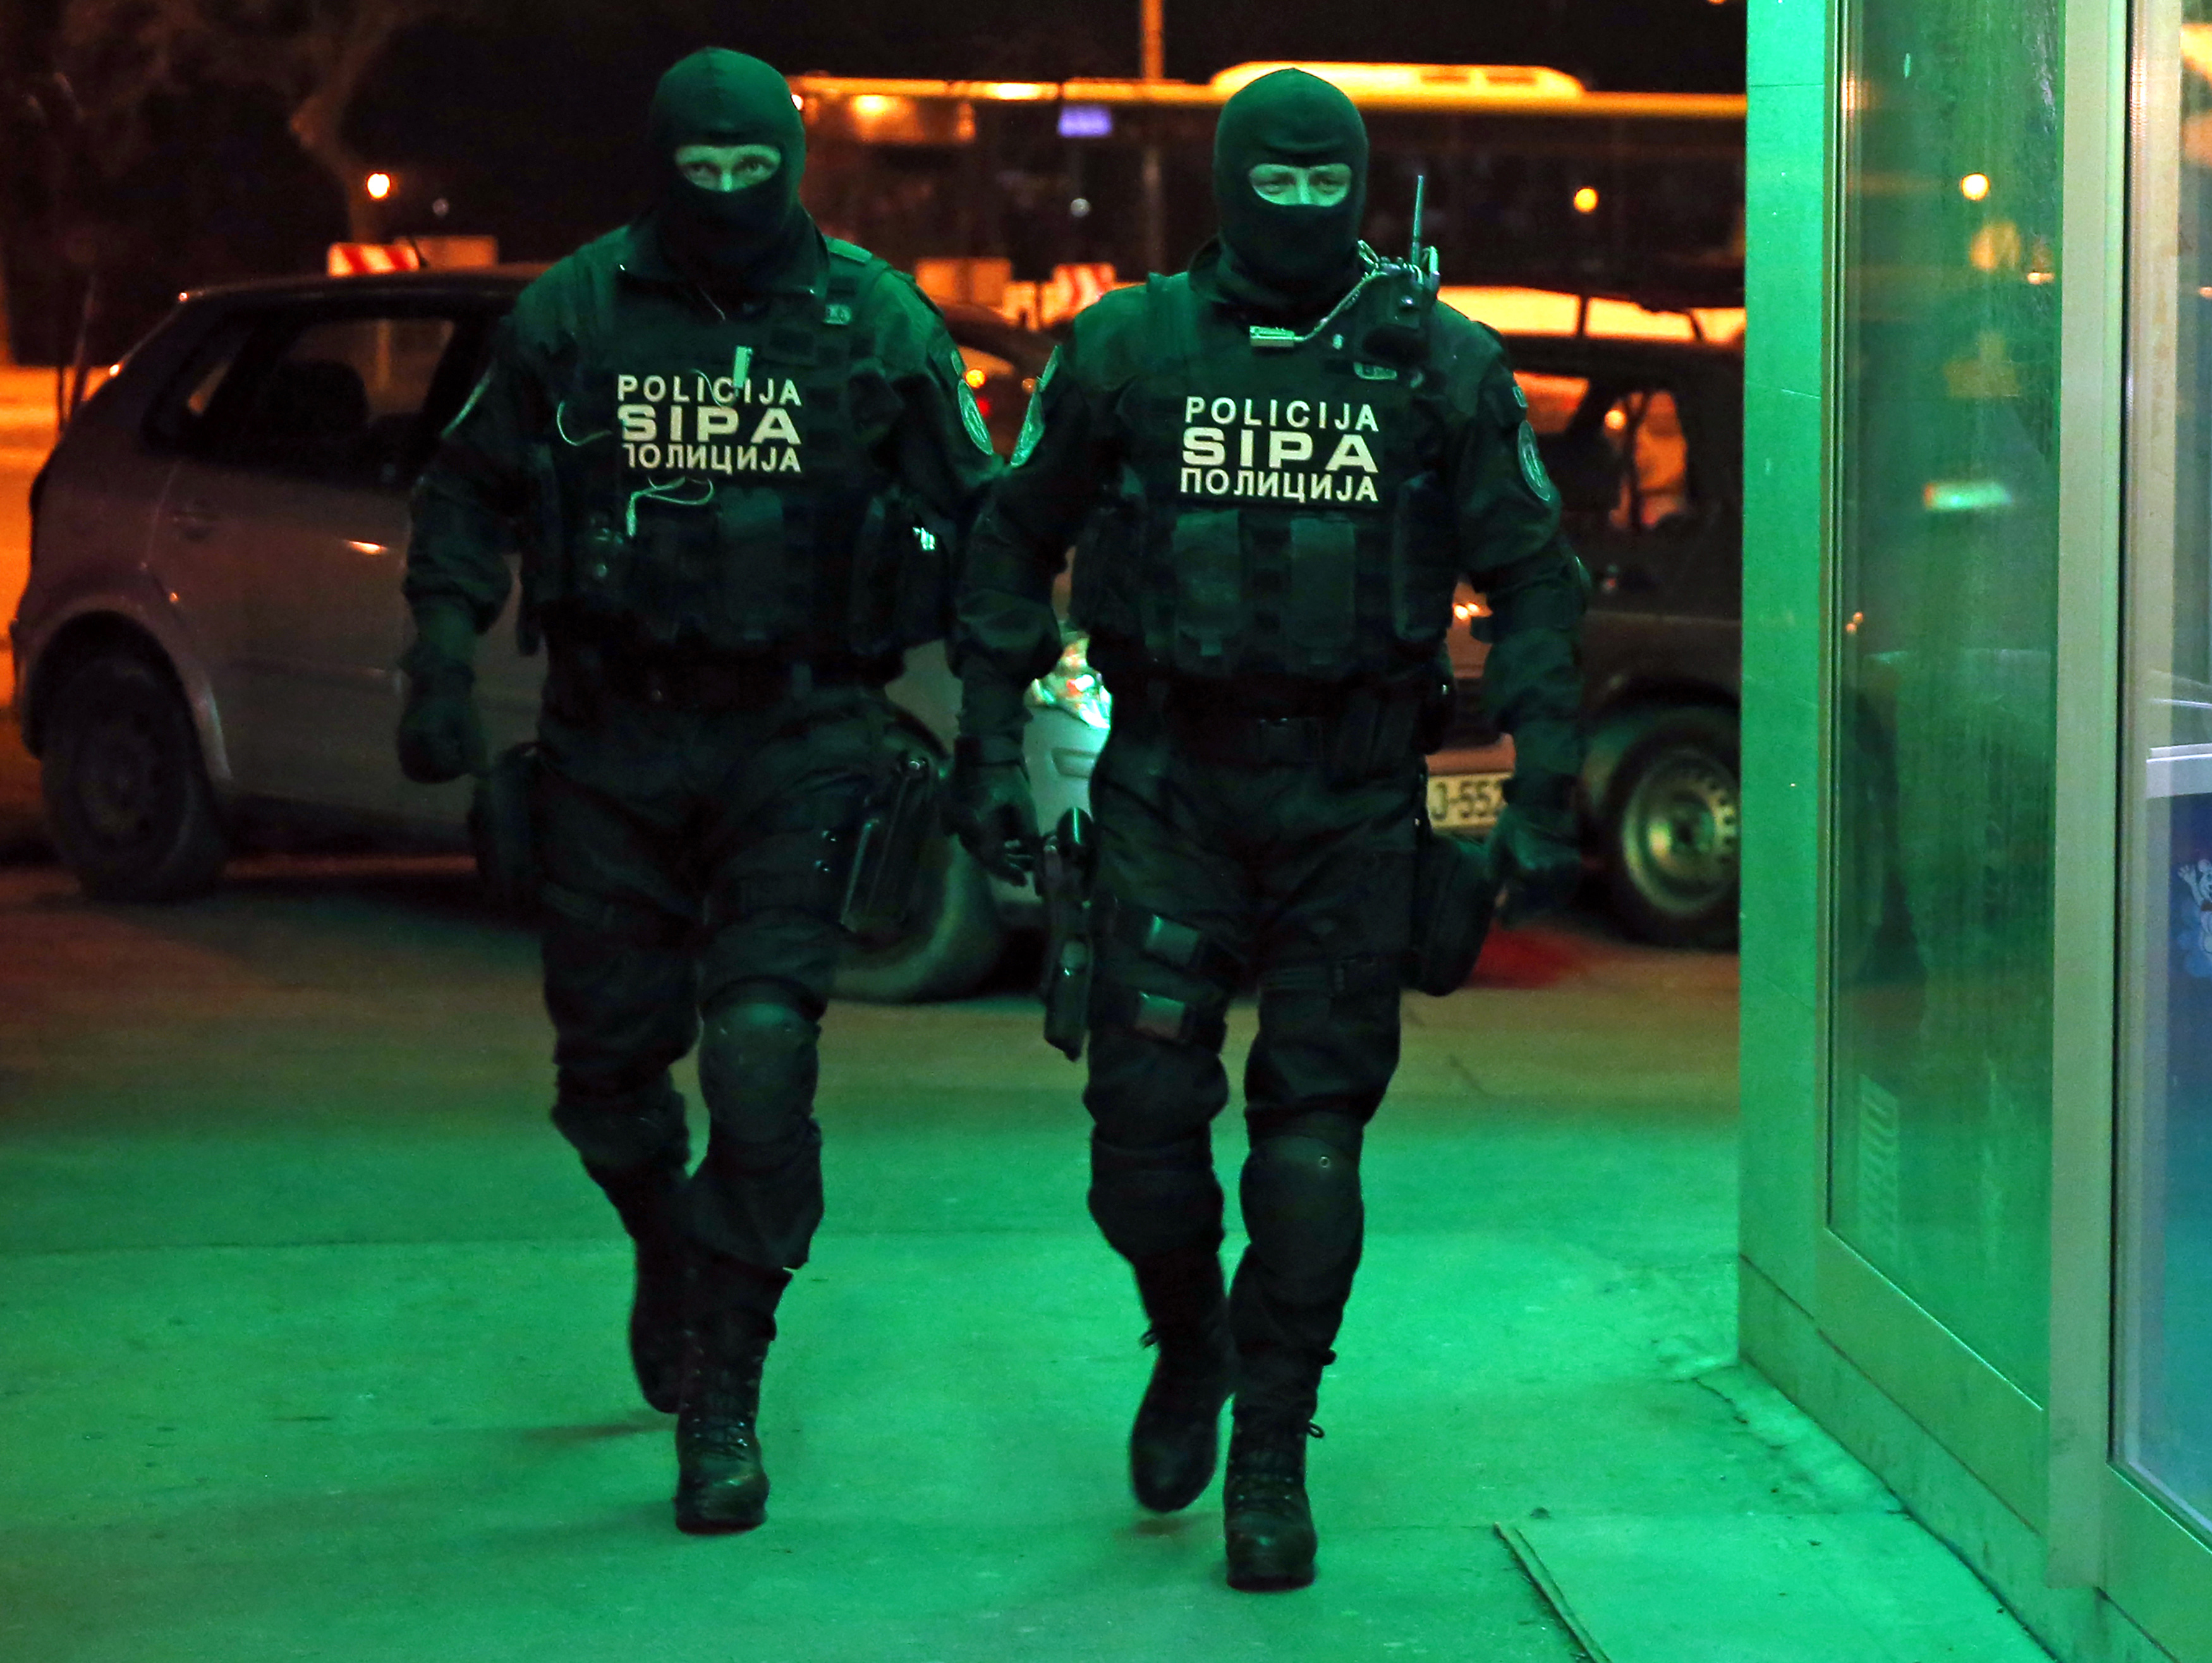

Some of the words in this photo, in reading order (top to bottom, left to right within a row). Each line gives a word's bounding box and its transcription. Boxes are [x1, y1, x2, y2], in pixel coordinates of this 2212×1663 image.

[618, 375, 802, 406] POLICIJA
[617, 404, 802, 444] SIPA
[1185, 396, 1379, 432] POLICIJA
[1183, 427, 1379, 473] SIPA
[1181, 468, 1379, 504] ПОЛИЦИЈА
